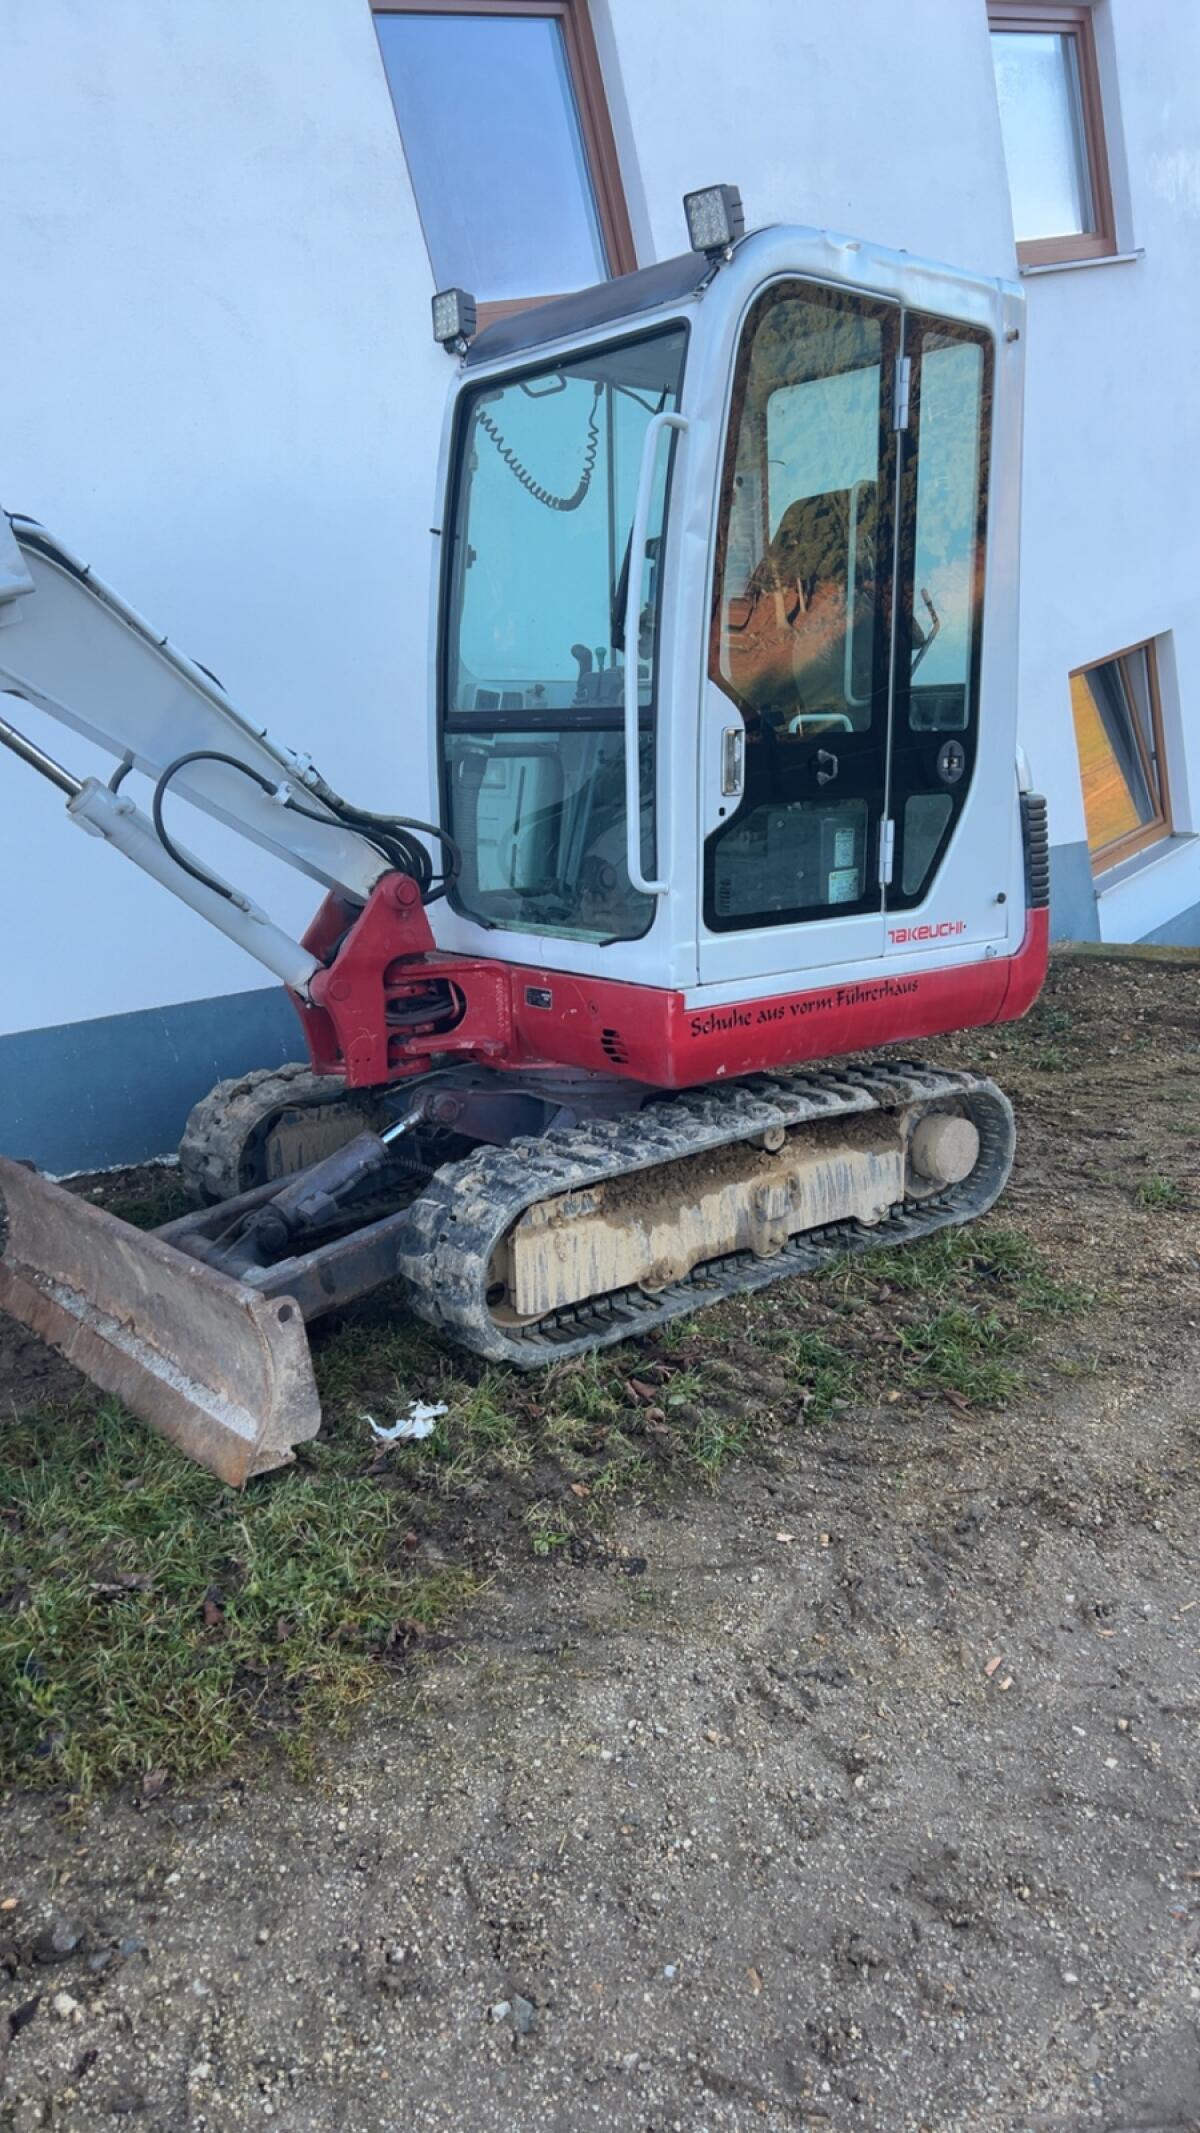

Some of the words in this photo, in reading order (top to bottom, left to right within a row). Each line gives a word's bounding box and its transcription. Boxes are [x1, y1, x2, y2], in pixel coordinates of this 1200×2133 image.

[690, 1010, 752, 1037] Schuhe
[757, 1006, 785, 1024] aus
[790, 997, 833, 1016] vorm
[836, 979, 919, 1007] Führerhaus
